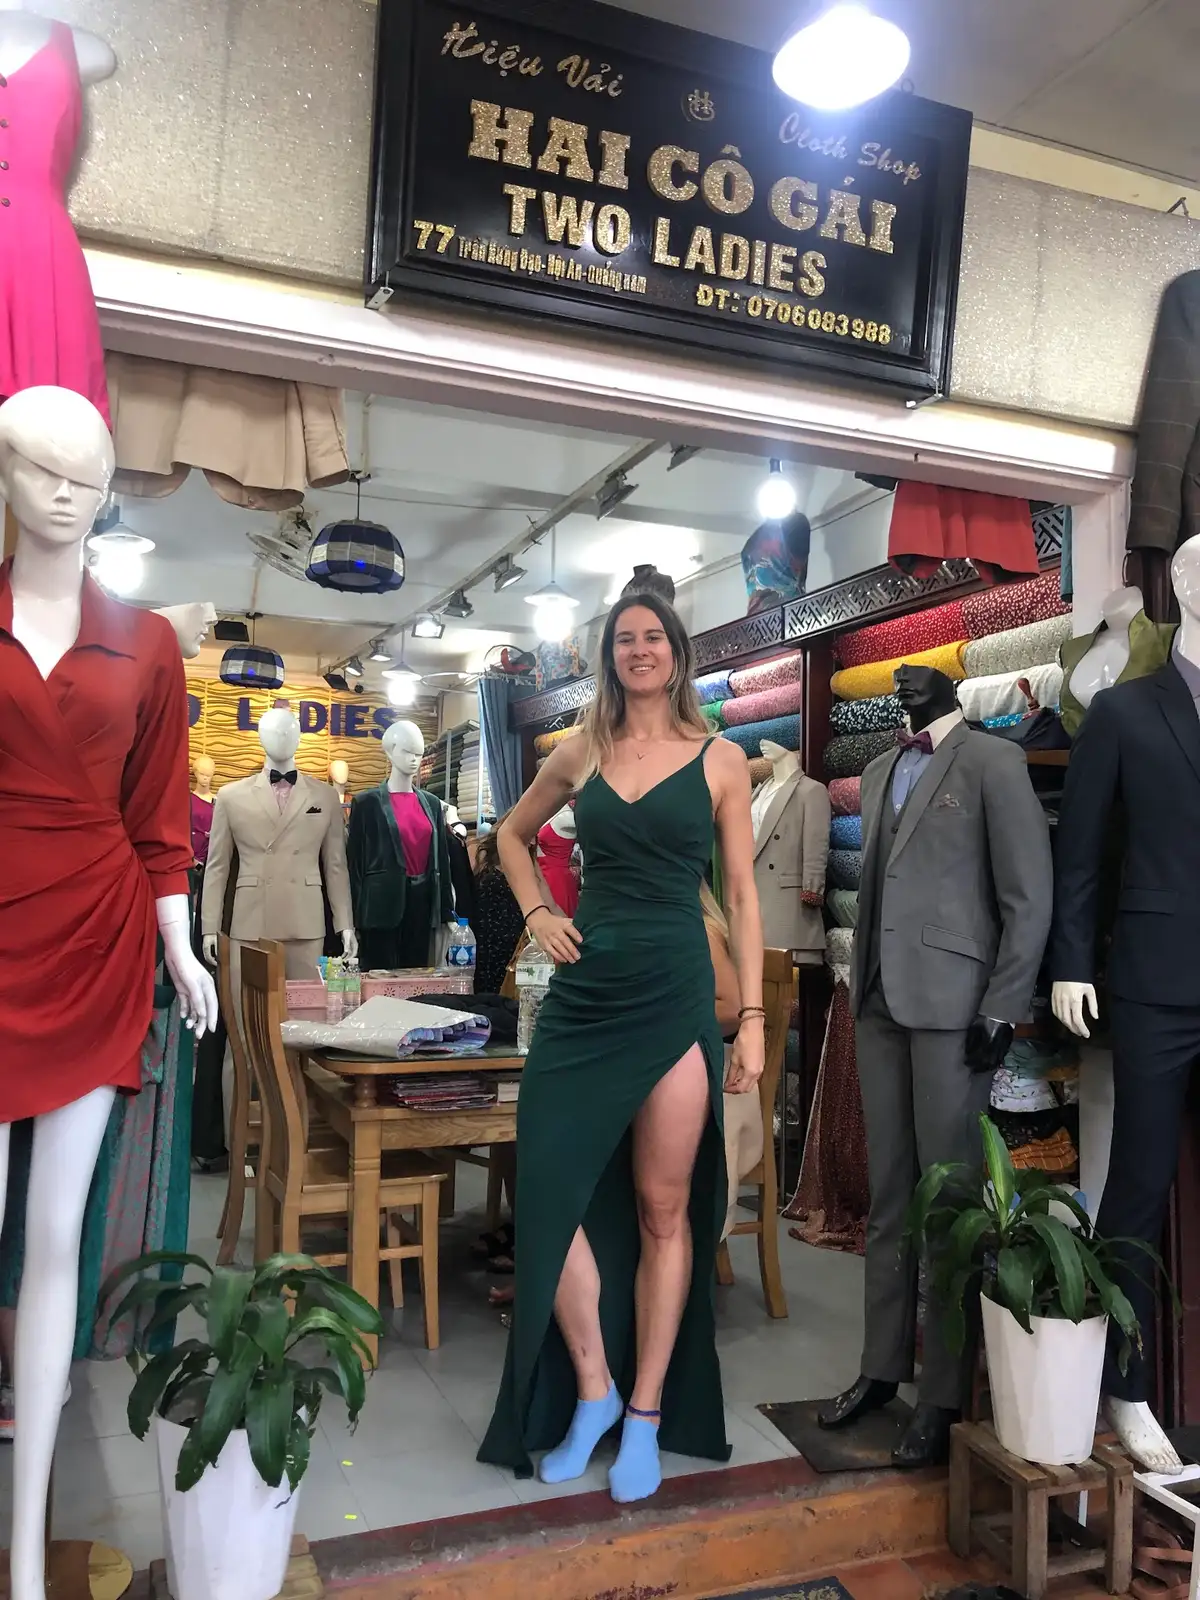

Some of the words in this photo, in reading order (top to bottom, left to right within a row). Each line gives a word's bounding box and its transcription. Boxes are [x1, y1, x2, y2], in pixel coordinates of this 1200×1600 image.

[557, 54, 622, 97] Vải
[468, 99, 631, 190] HAI
[647, 144, 754, 215] CÔ
[779, 111, 847, 159] Cloth
[857, 142, 922, 185] Shop
[413, 219, 456, 254] 77
[503, 183, 632, 255] TWO
[653, 216, 827, 297] LADIES
[236, 697, 398, 740] LDIES
